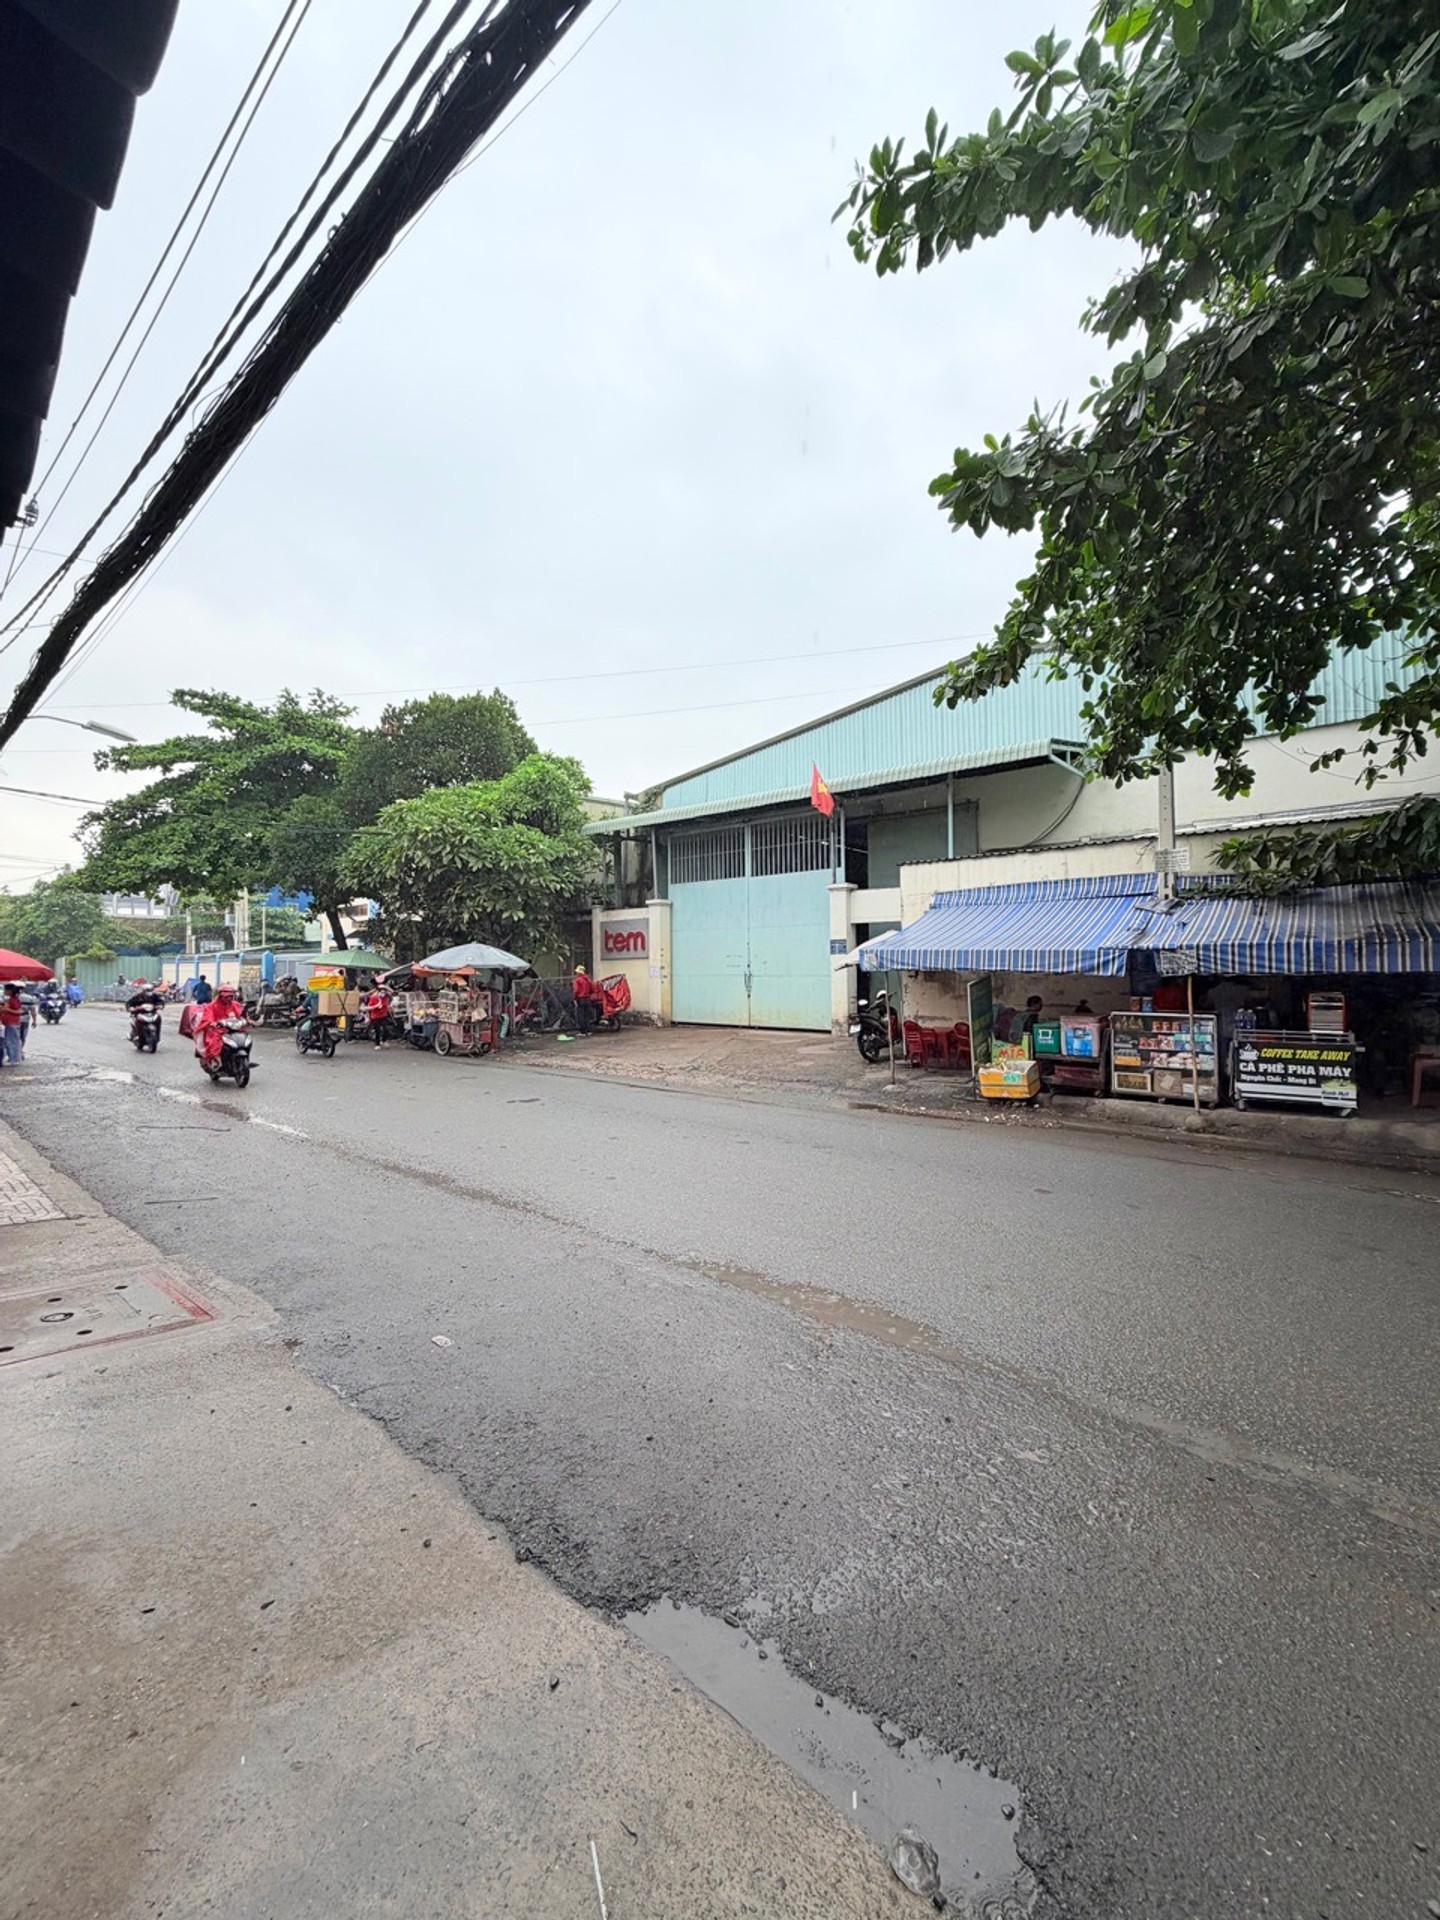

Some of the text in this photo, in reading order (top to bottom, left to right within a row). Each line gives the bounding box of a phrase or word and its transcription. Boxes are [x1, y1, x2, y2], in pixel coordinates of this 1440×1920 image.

[604, 929, 646, 952] tem
[1261, 1048, 1351, 1061] COFFEE TAKE AWAY
[1259, 1062, 1285, 1074] PHÊ
[1288, 1065, 1316, 1075] PHA
